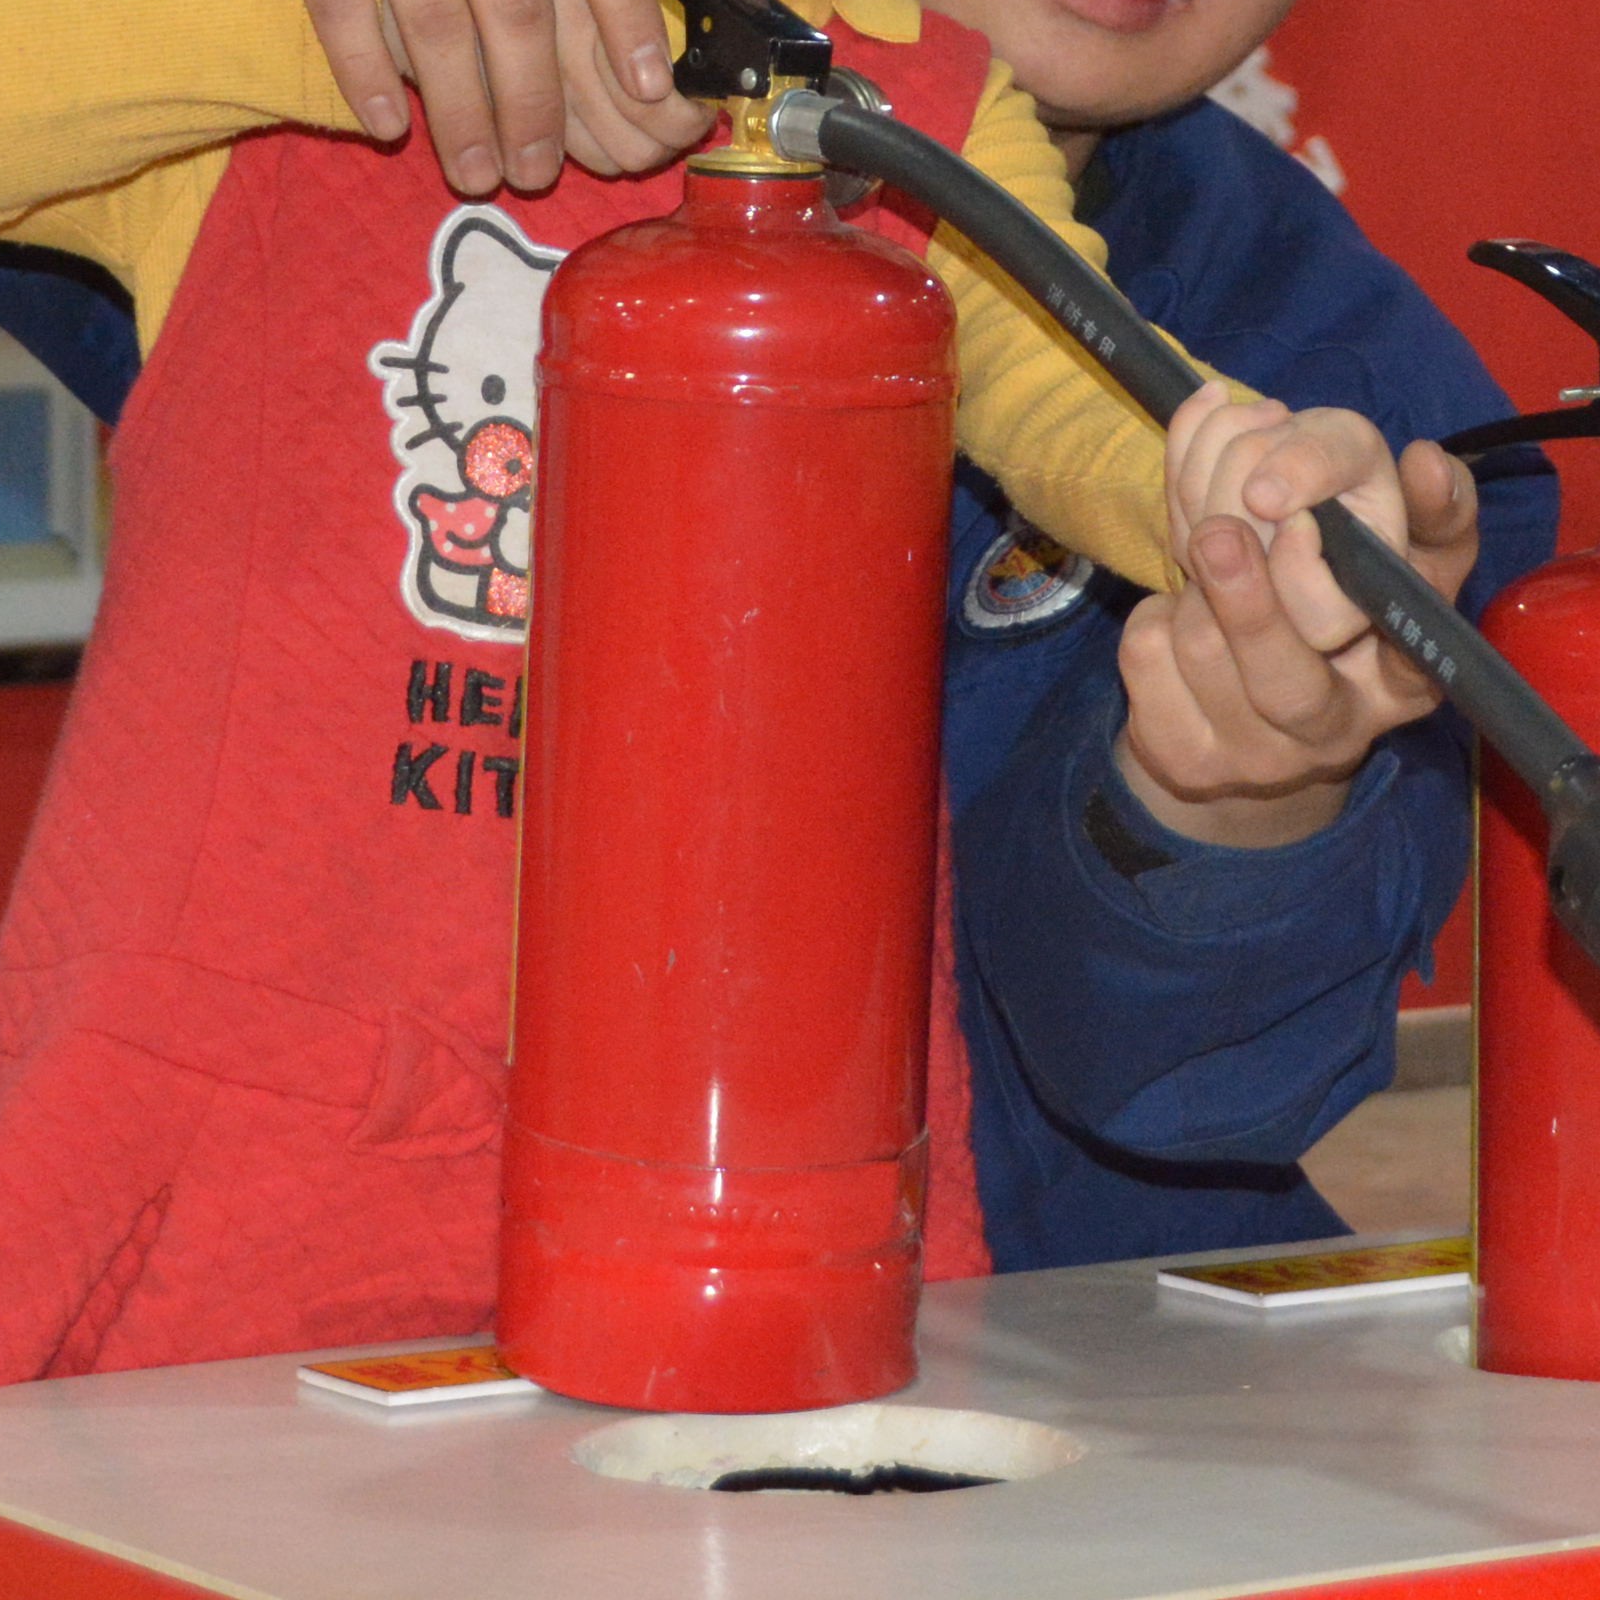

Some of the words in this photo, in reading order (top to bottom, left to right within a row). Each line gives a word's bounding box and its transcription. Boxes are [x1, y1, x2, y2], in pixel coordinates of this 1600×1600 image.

[1046, 283, 1117, 361] 消防专用
[1385, 601, 1456, 683] 消防专用
